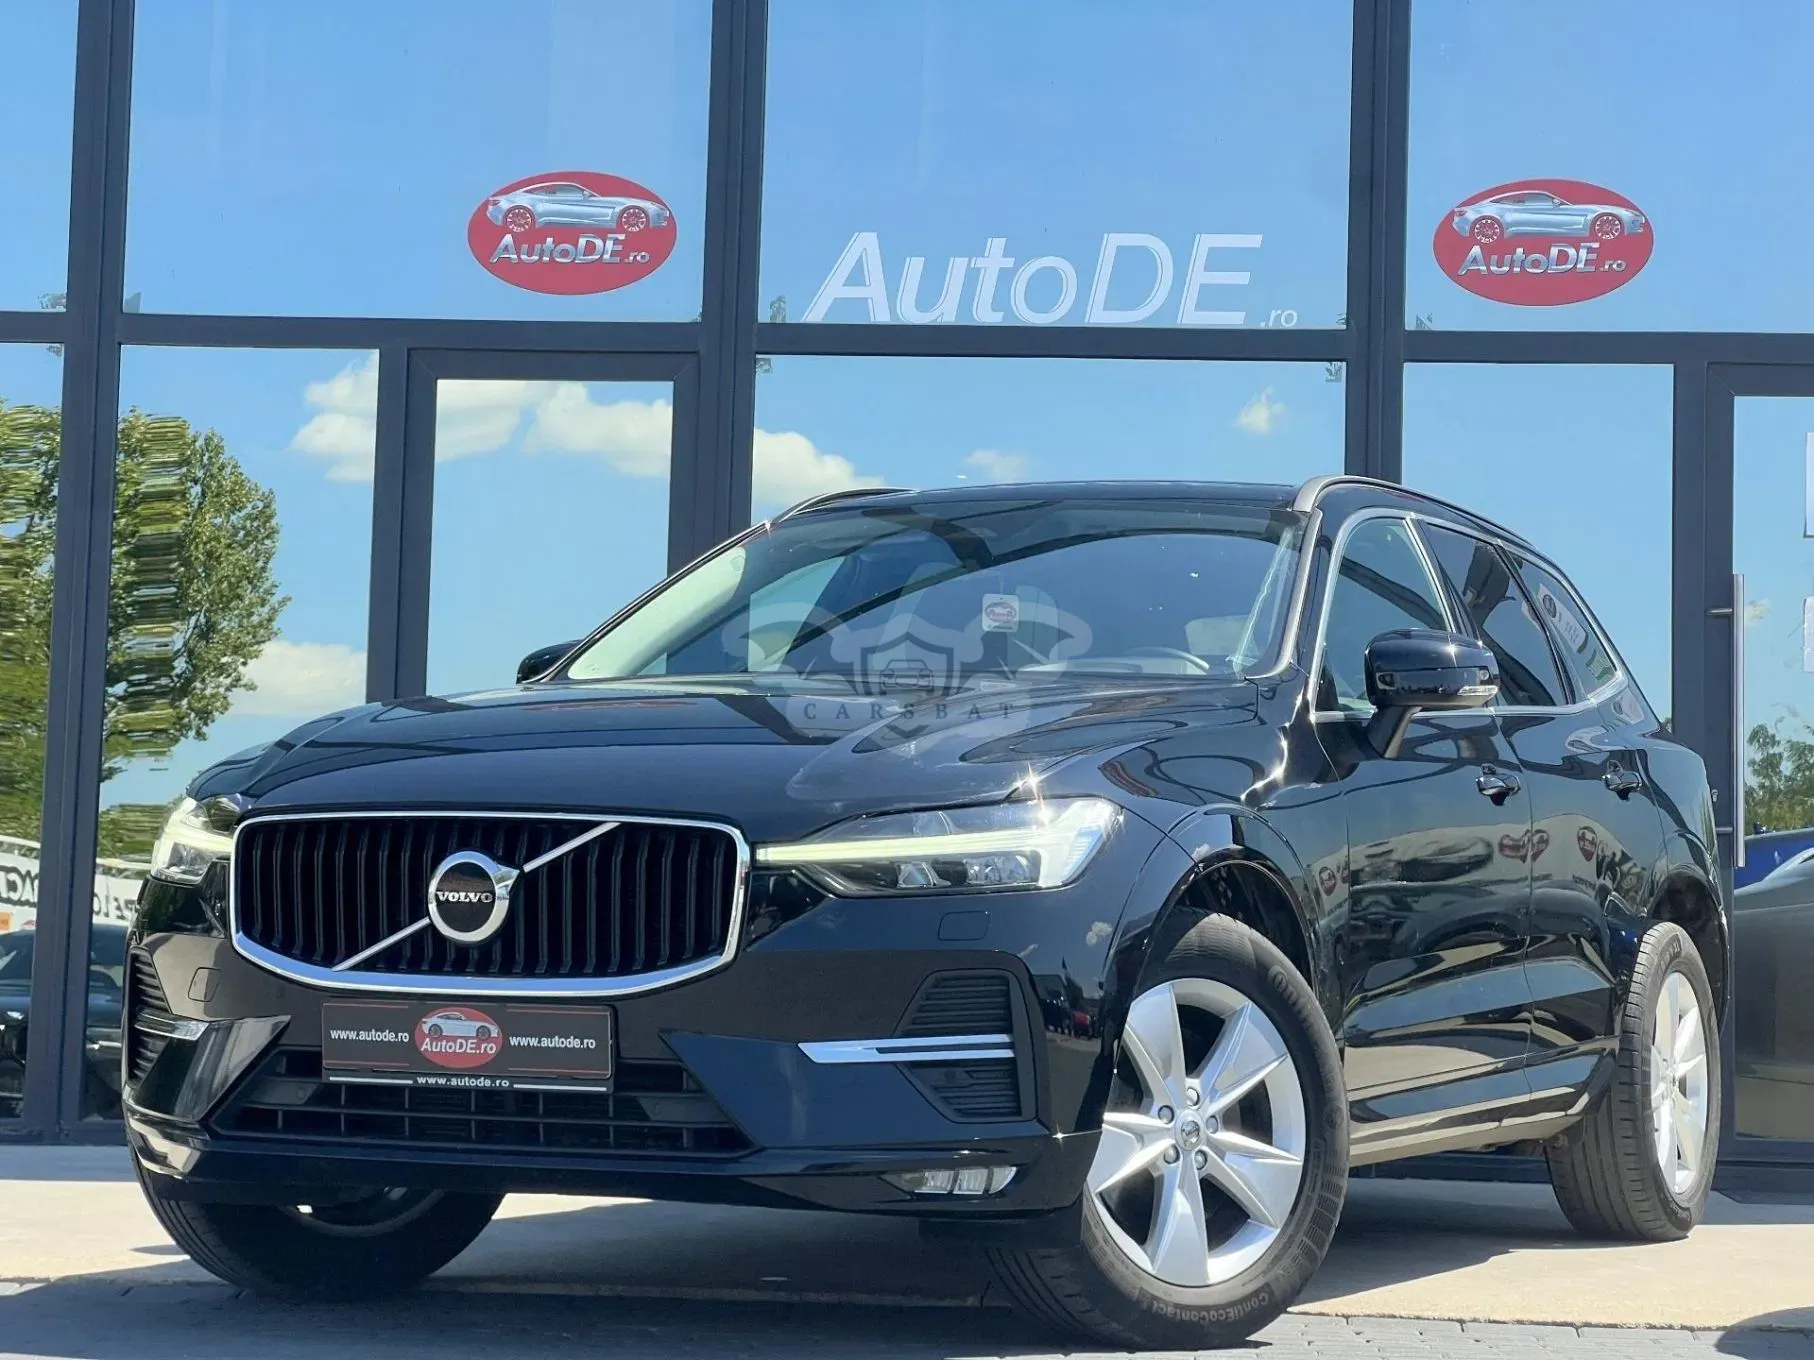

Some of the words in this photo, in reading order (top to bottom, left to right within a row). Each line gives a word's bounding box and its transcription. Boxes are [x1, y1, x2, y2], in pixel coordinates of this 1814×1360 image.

[436, 891, 493, 903] VOLVO
[329, 1027, 409, 1043] www.autode.ro
[509, 1034, 596, 1049] www.autode.ro
[420, 1037, 497, 1055] AutoDE.ro
[416, 1075, 510, 1088] www.autode.ro
